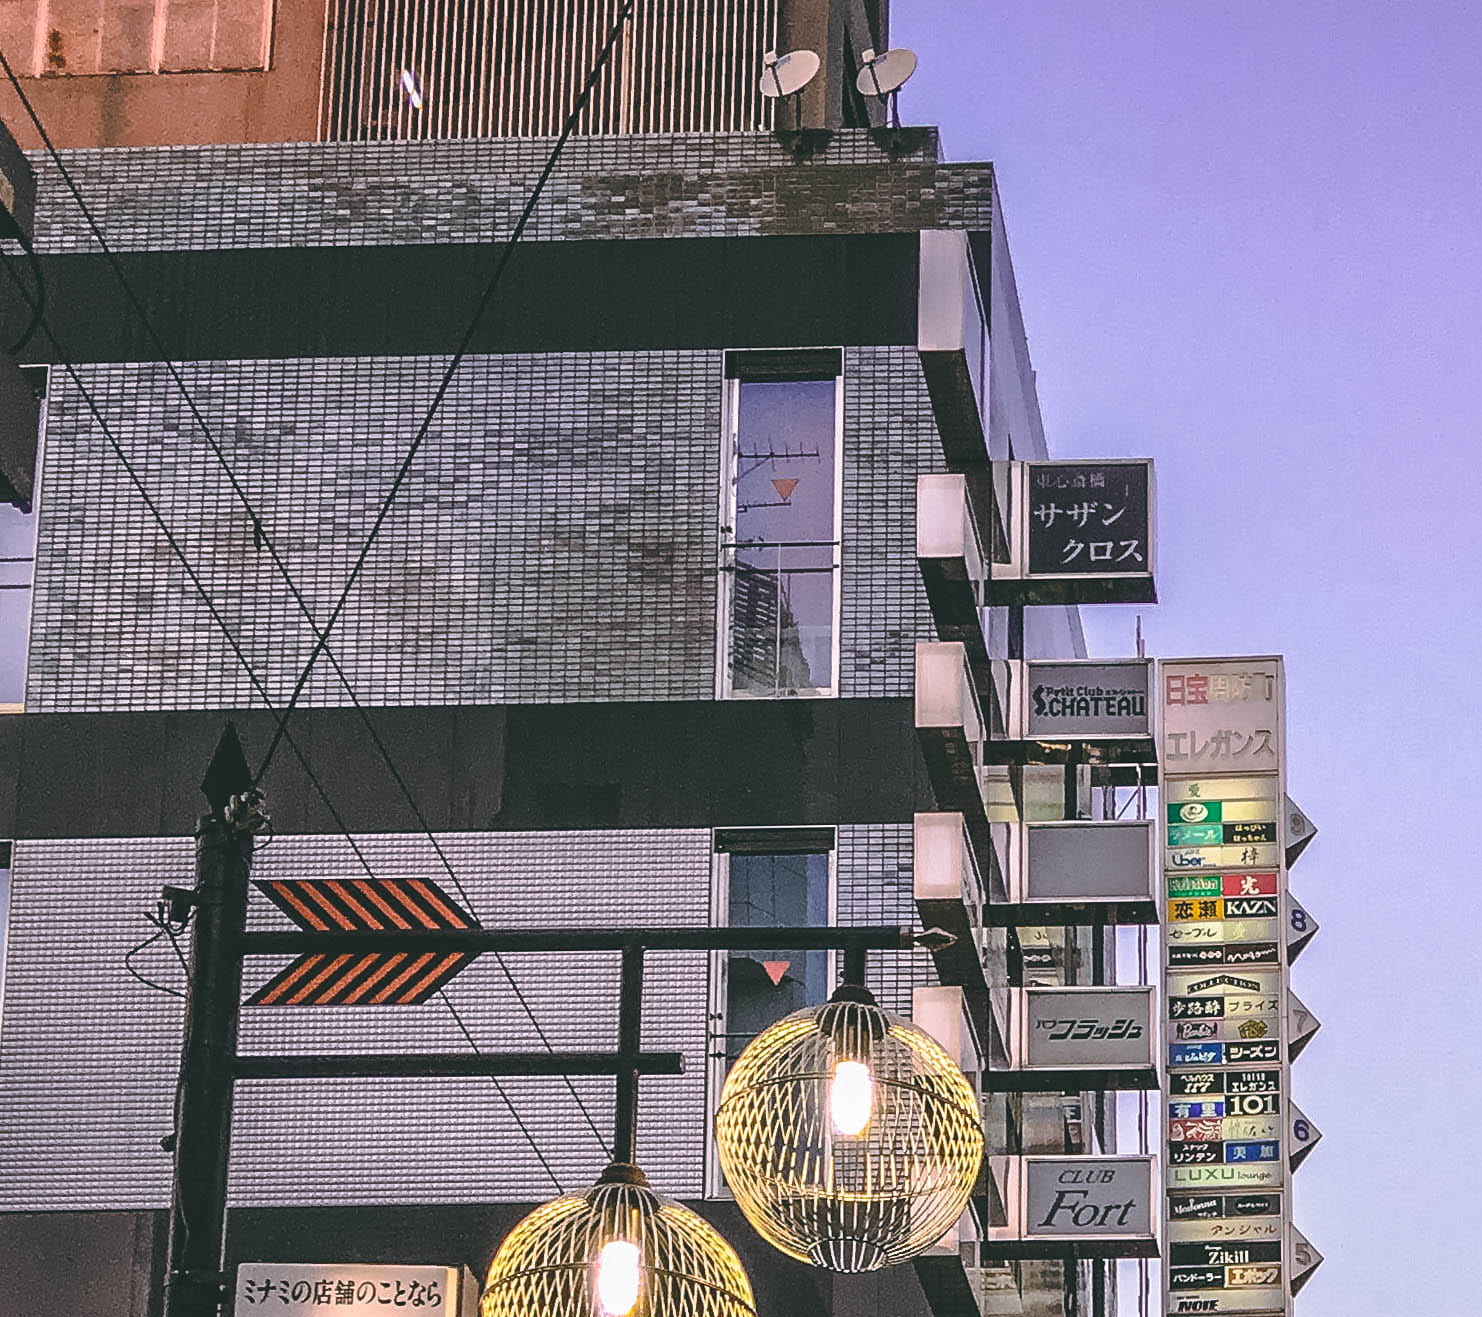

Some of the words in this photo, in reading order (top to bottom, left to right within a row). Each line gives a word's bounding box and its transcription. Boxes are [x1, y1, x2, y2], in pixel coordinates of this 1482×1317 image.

[1033, 502, 1127, 528] サザン
[1062, 539, 1143, 565] クロス
[1166, 730, 1276, 760] エレガンス
[1240, 876, 1260, 895] 光
[1291, 909, 1307, 932] 8
[1230, 1096, 1276, 1115] 101
[1293, 1119, 1310, 1141] 6
[1058, 1170, 1115, 1184] CLUB
[1037, 1190, 1136, 1227] Fort
[244, 1279, 443, 1307] ミナミの店舗のことなら
